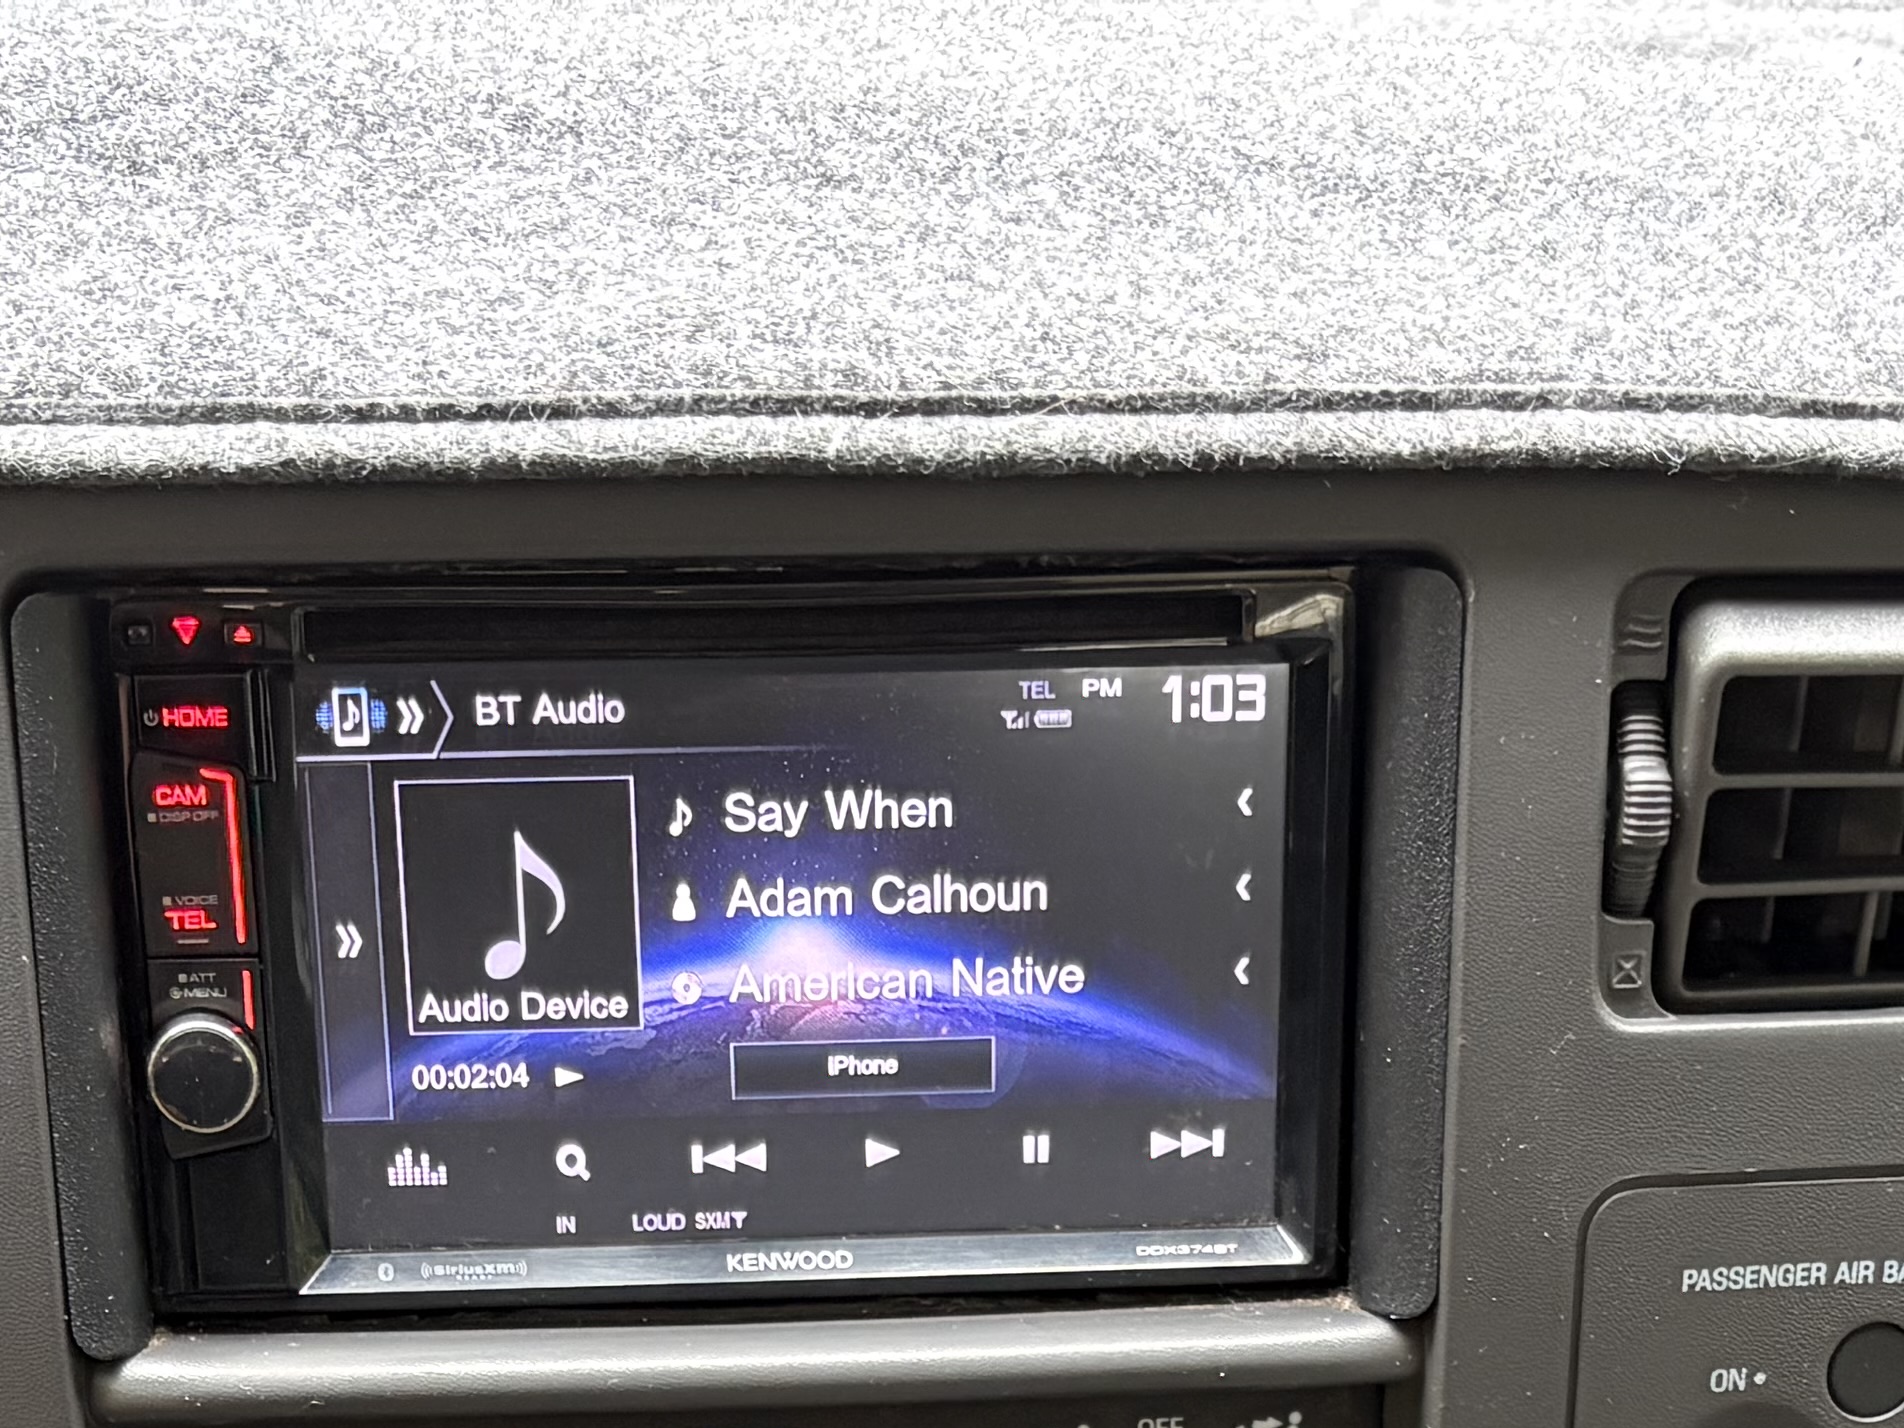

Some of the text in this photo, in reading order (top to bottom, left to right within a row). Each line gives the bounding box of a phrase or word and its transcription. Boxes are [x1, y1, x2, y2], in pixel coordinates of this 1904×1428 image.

[1018, 680, 1056, 700] TEL
[1081, 673, 1267, 724] PM 1:03
[162, 706, 228, 727] HOME
[475, 692, 626, 726] BT Audio
[154, 785, 207, 806] CAM
[724, 788, 953, 838] Say When
[175, 895, 218, 905] VOICE
[725, 873, 1048, 917] Adam Calhoun
[164, 909, 218, 930] TEL
[189, 973, 216, 984] ATT
[728, 957, 1086, 1003] American Native
[183, 987, 227, 998] MENU
[418, 988, 630, 1024] Audio Device
[411, 1064, 529, 1090] 00:02:04
[556, 1215, 577, 1234] IN
[631, 1212, 687, 1232] LOUD
[726, 1250, 855, 1274] KENWOOD
[1681, 1262, 1828, 1293] PASSENGER
[1833, 1260, 1875, 1285] AIR
[1710, 1367, 1748, 1393] ON
